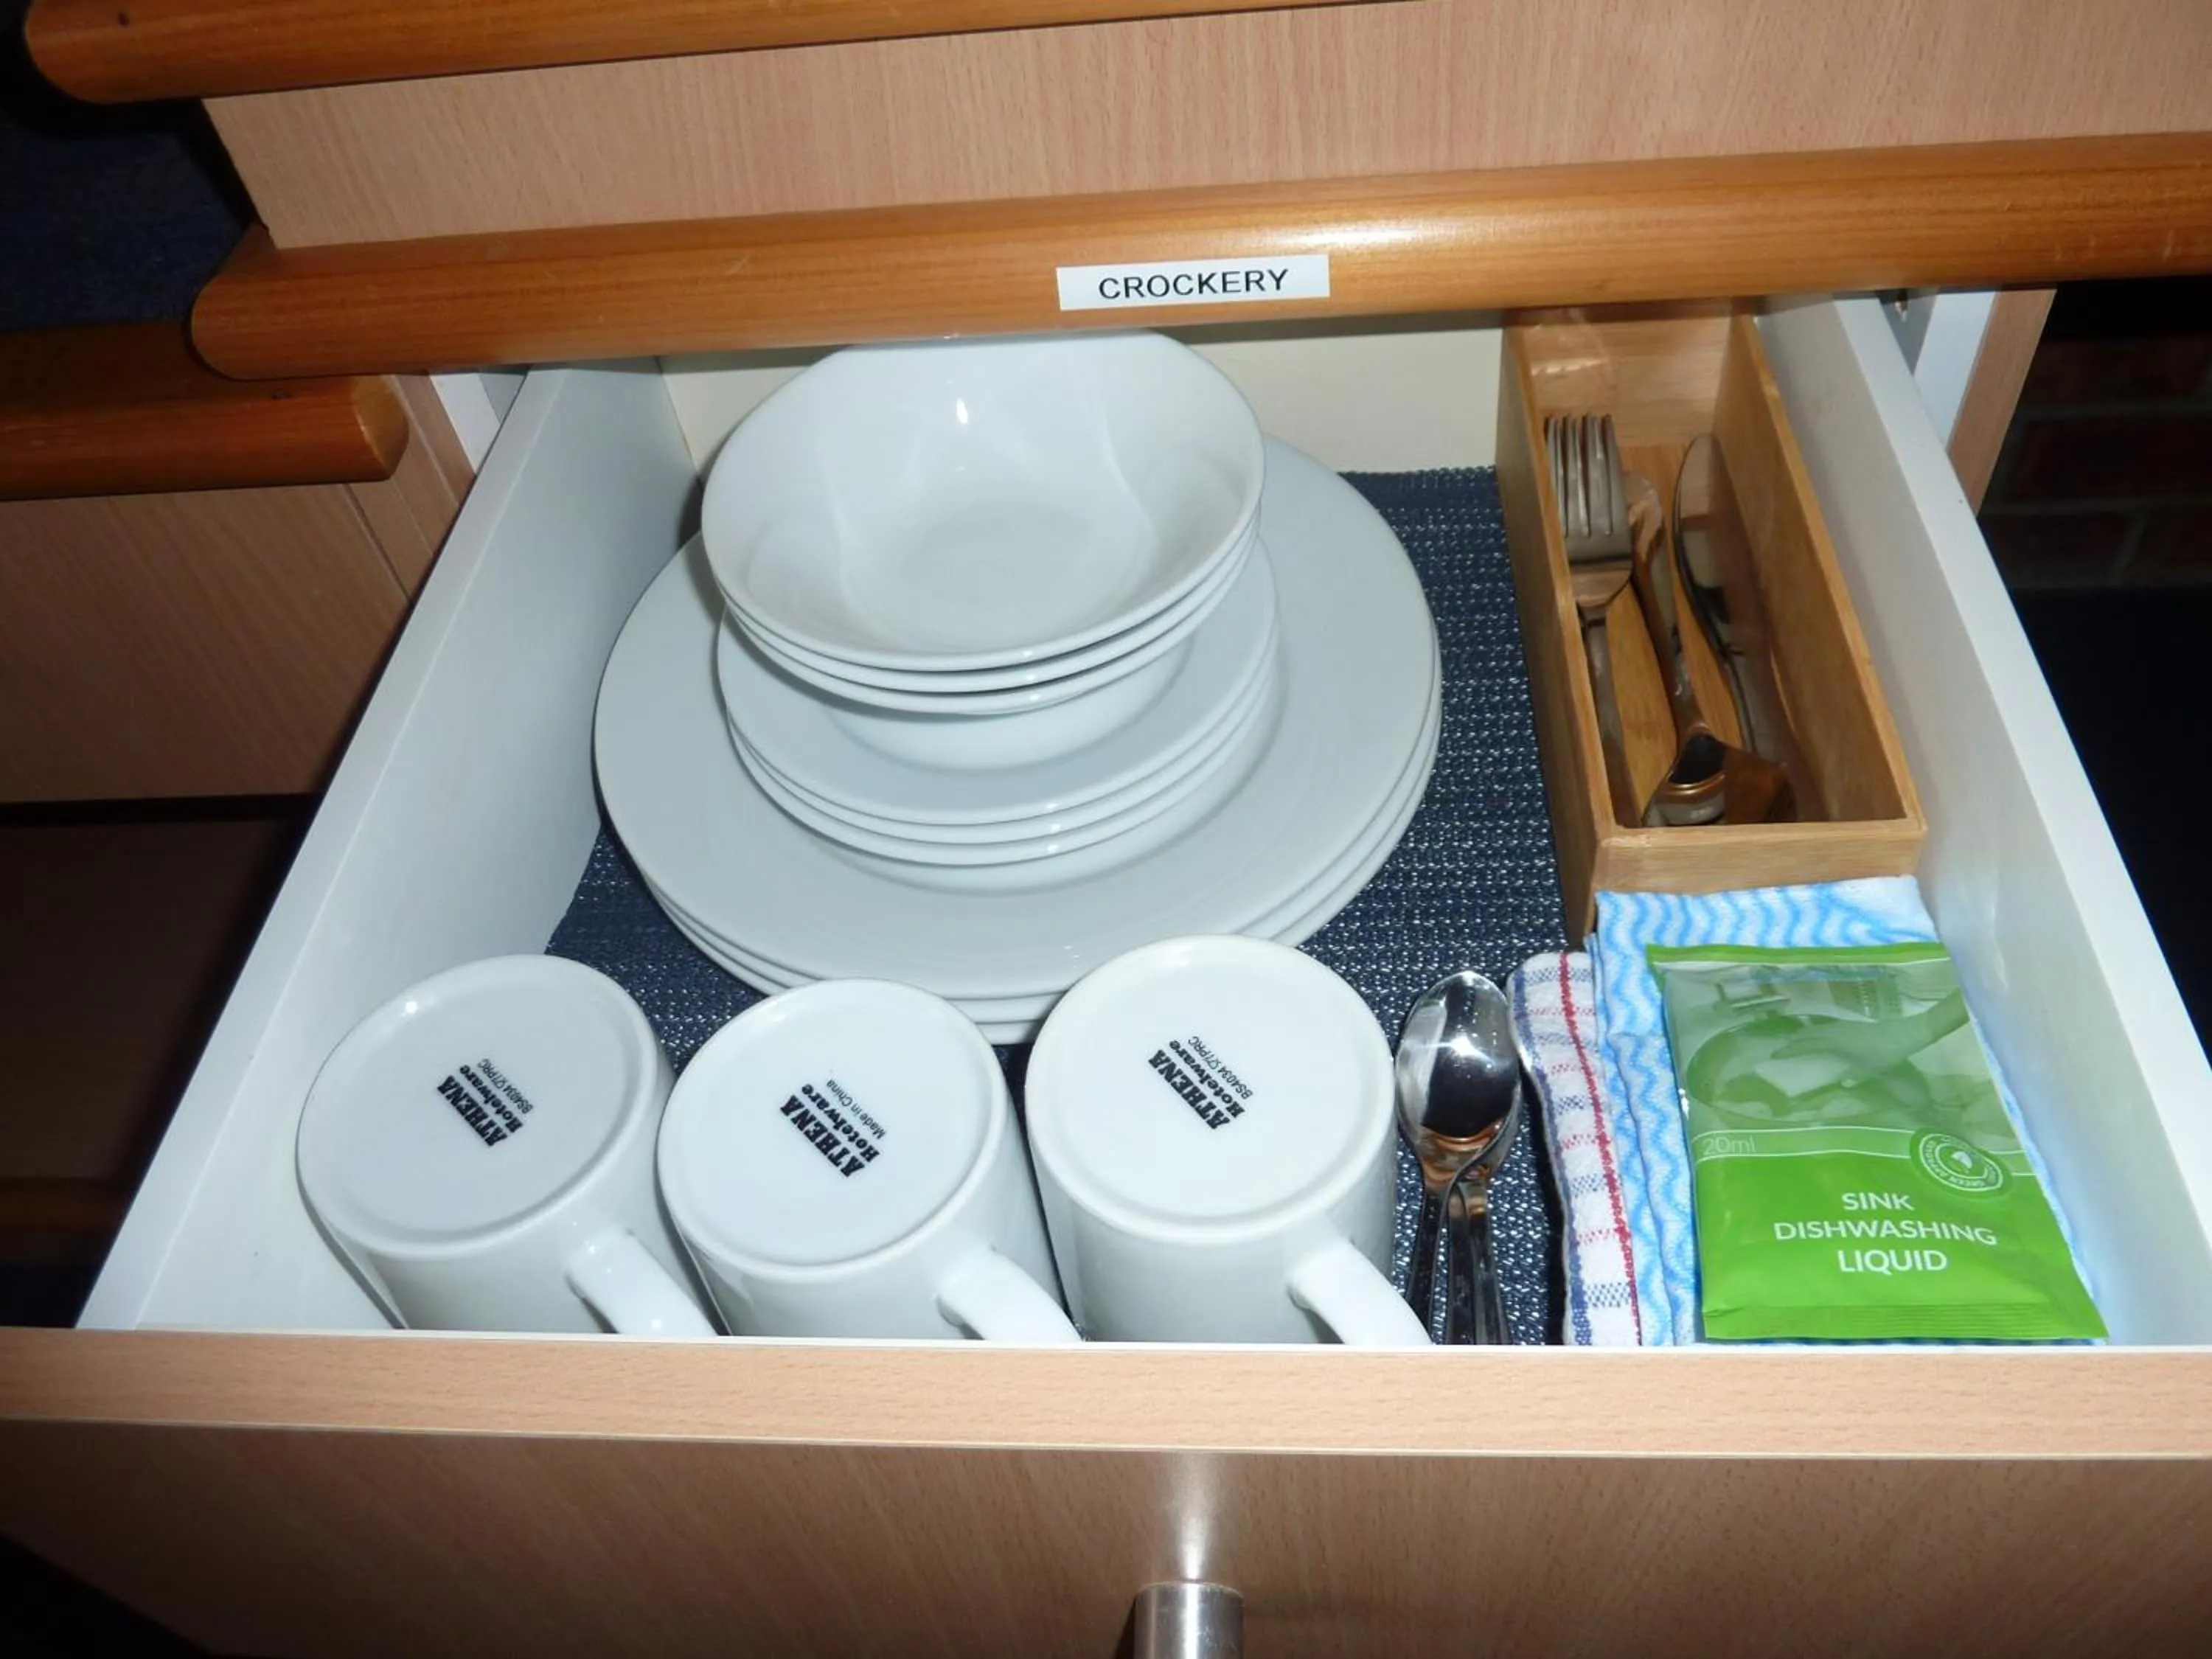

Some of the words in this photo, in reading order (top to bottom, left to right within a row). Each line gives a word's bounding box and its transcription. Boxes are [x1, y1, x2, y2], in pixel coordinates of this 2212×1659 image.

[1099, 268, 1288, 299] CROCKERY
[827, 1079, 853, 1107] China
[1148, 1049, 1231, 1130] ATHENA
[1169, 1040, 1245, 1118] Hotelware
[1217, 1065, 1253, 1099] BS4034
[437, 1075, 508, 1147] ATHENA
[459, 1065, 523, 1133] Hotelware
[850, 1103, 863, 1116] in
[780, 1094, 865, 1177] ATHENA
[801, 1084, 880, 1163] Hotelware
[859, 1113, 886, 1139] Made
[1702, 1135, 1756, 1156] 20ml
[1842, 1192, 1915, 1211] SINK
[1773, 1220, 1997, 1245] DISHWASHING
[1837, 1250, 1947, 1275] LIQUID
